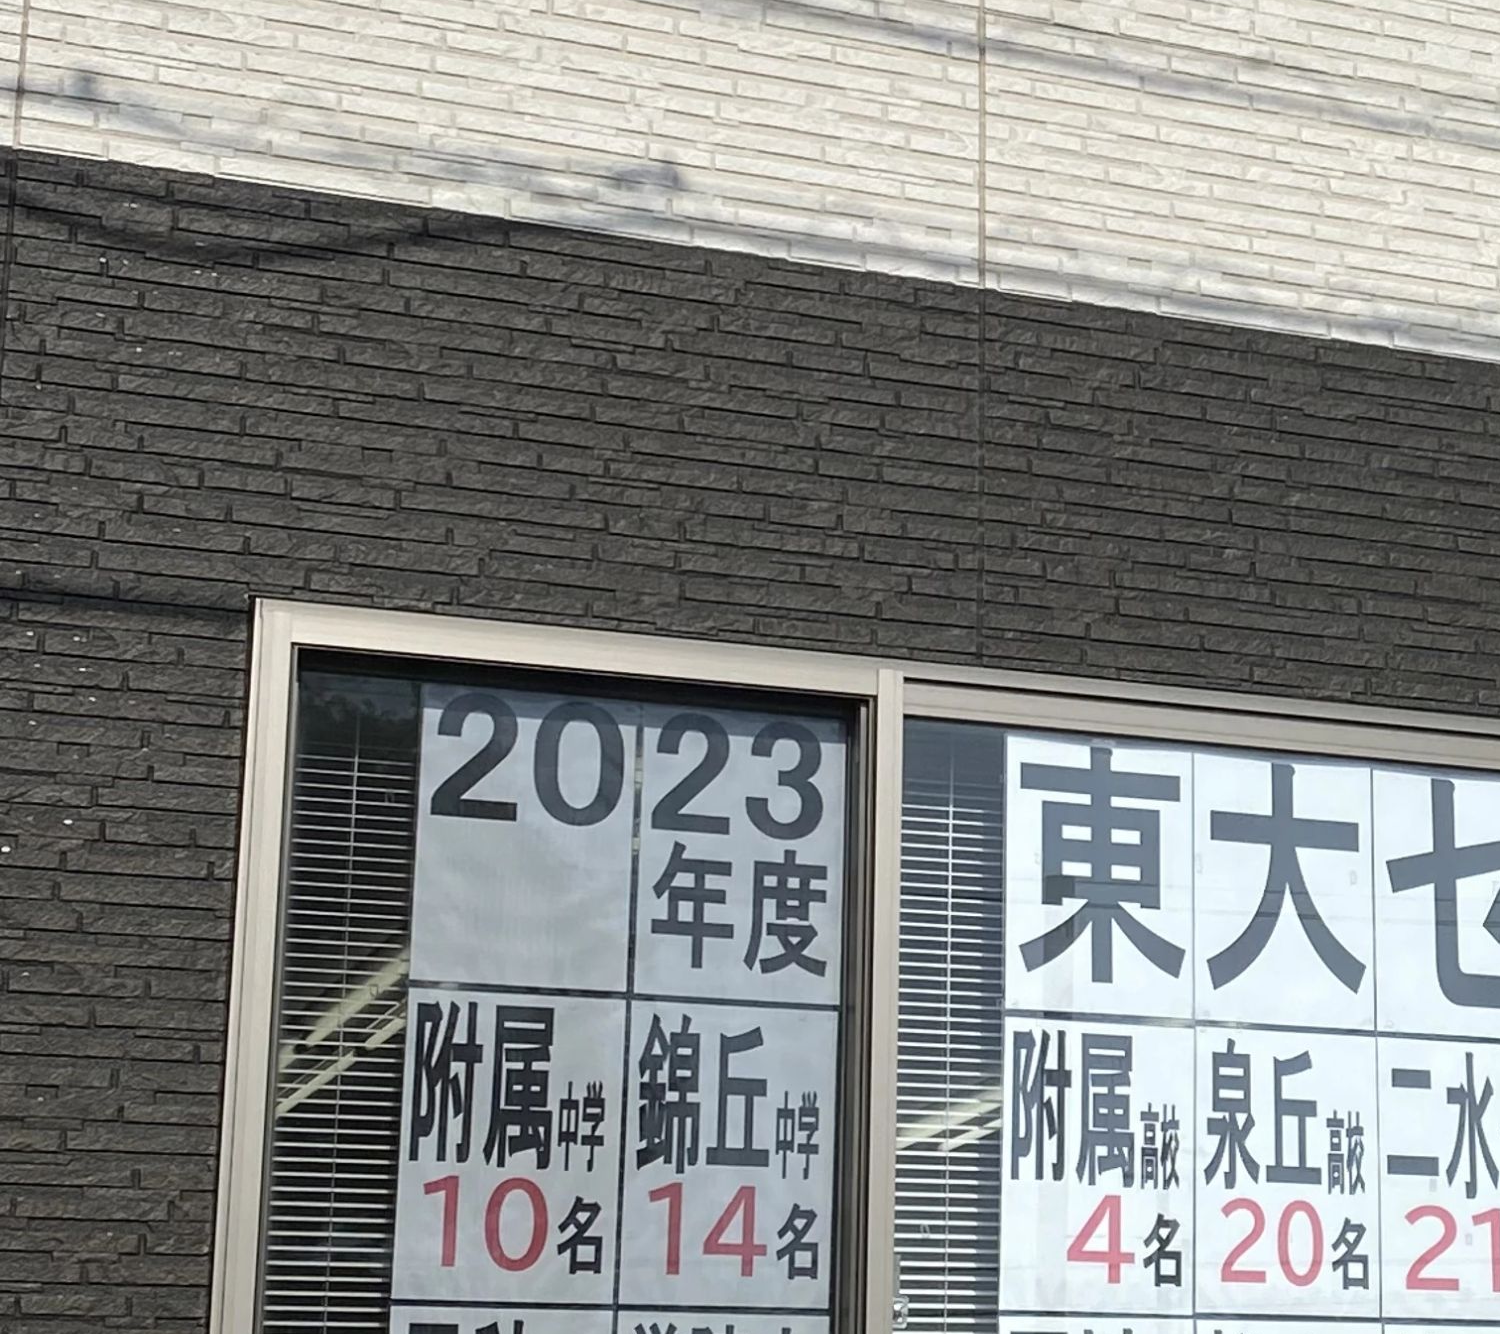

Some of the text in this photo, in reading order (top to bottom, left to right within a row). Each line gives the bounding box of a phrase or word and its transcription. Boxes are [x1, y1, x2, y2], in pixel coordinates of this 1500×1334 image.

[430, 693, 824, 840] 2023
[651, 841, 828, 977] 年度
[408, 1001, 606, 1173] 附属中学
[637, 1013, 819, 1180] 錦丘中学
[1010, 1029, 1180, 1190] 附属高校
[1204, 1038, 1366, 1195] 泉丘高校
[423, 1175, 602, 1275] 10名
[648, 1182, 818, 1280] 14名
[1067, 1195, 1182, 1287] 4名
[1220, 1197, 1369, 1290] 20名
